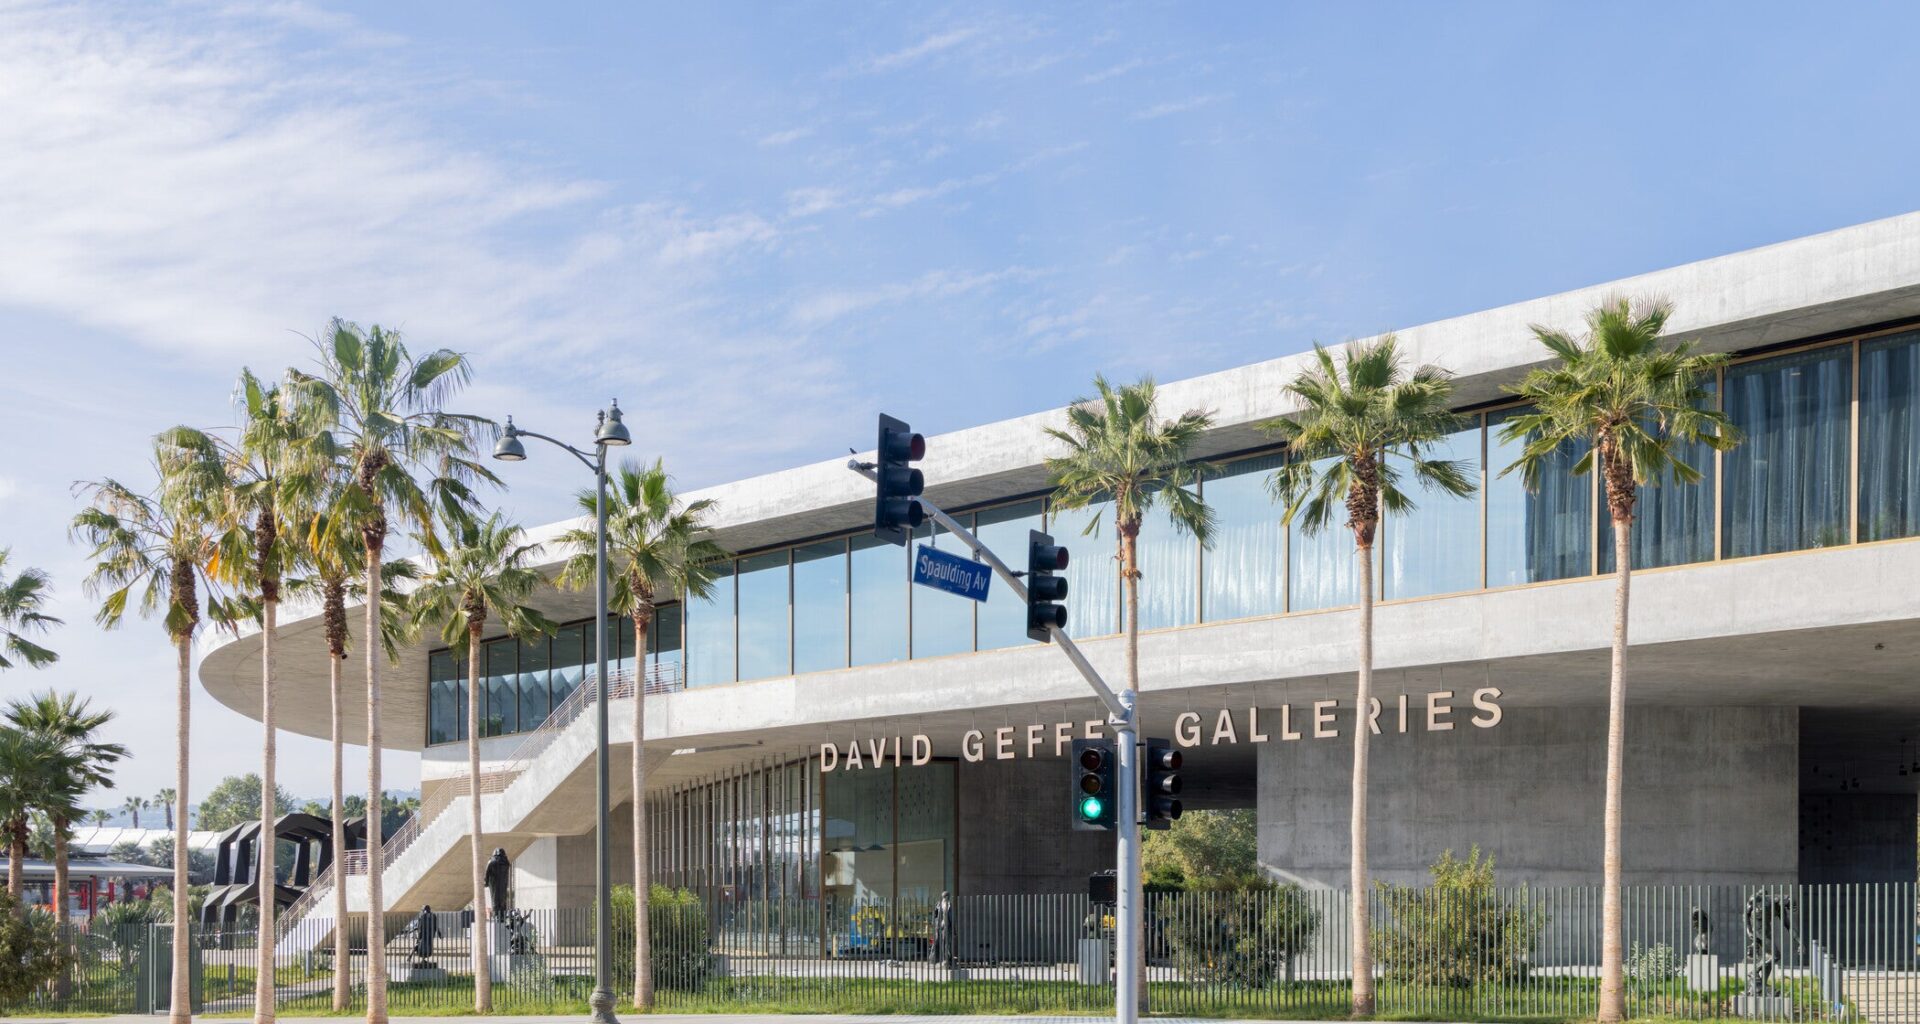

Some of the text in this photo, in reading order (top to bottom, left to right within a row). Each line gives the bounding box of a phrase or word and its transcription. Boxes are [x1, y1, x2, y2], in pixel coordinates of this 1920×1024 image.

[920, 555, 972, 592] Spaulding
[973, 571, 987, 591] Av
[820, 687, 1503, 773] DAVID GEFFE GALLERIES
